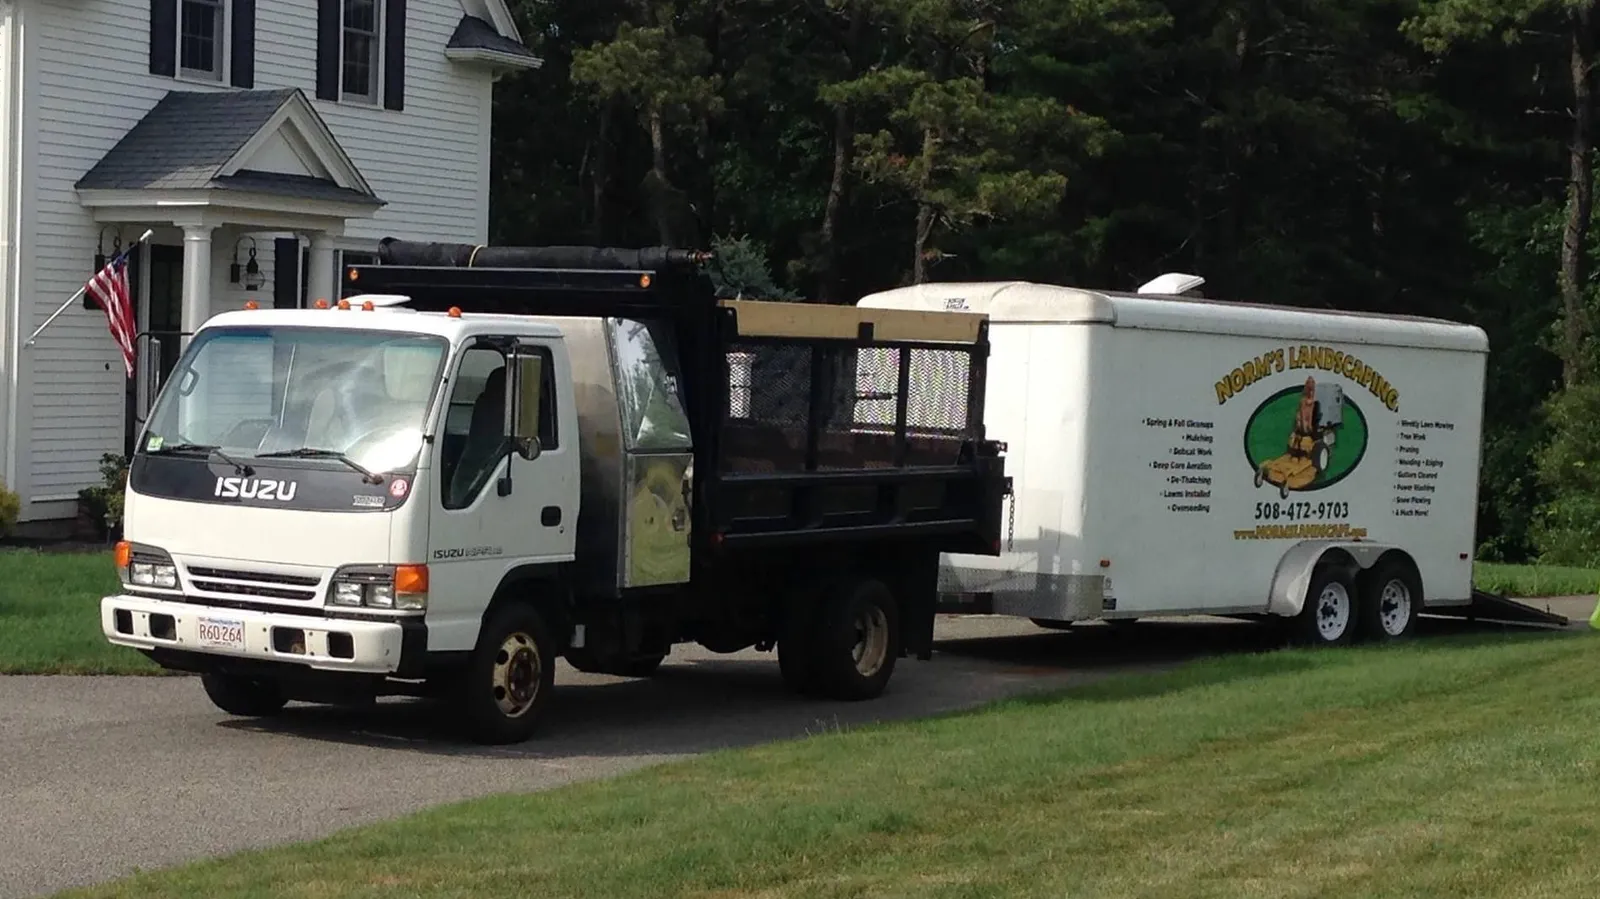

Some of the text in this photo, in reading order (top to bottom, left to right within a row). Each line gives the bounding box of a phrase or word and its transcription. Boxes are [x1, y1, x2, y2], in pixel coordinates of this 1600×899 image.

[1214, 345, 1399, 412] NORM'S LANDSCAPING
[1146, 418, 1167, 429] Spring
[1174, 418, 1185, 427] Fall
[1186, 420, 1214, 429] Cleanups
[1420, 420, 1434, 429] Lawn
[1434, 421, 1454, 431] Mowing
[1185, 433, 1214, 444] Mulching
[1400, 432, 1411, 440] Tree
[1173, 447, 1212, 456] Bobcat Work
[1399, 445, 1419, 454] Pruning
[1153, 460, 1213, 470] Deep Core Aeration
[1170, 475, 1212, 485] De-Thatching
[214, 476, 297, 502] ISUZU
[1396, 483, 1412, 491] Power
[1163, 490, 1211, 498] Lawns Installed
[1171, 503, 1210, 513] Overseeding
[1254, 501, 1349, 521] 508-472-9703
[1400, 508, 1413, 516] Much
[433, 547, 464, 559] ISUZU
